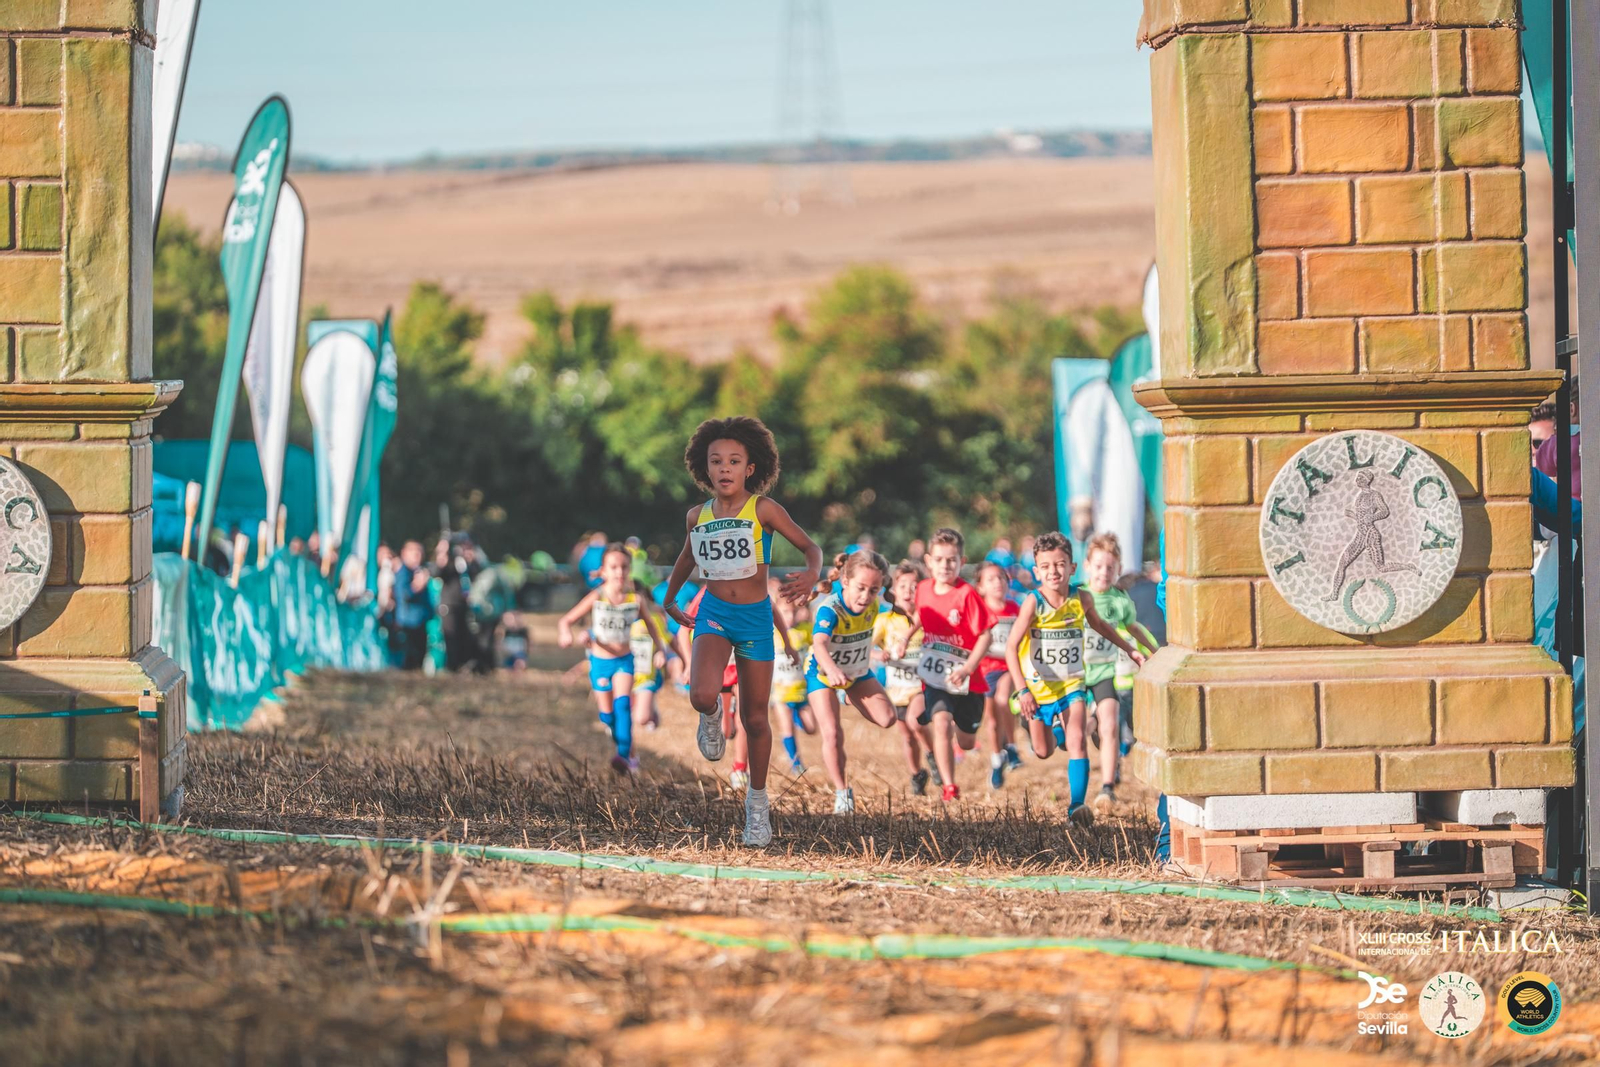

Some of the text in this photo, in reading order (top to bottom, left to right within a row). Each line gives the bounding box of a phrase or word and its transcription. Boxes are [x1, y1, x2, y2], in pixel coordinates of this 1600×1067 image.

[1269, 435, 1456, 575] ITALICA
[0, 467, 42, 576] CA
[699, 538, 751, 561] 4588
[831, 645, 868, 665] 4571
[923, 656, 965, 674] 463
[1034, 646, 1079, 664] 4583
